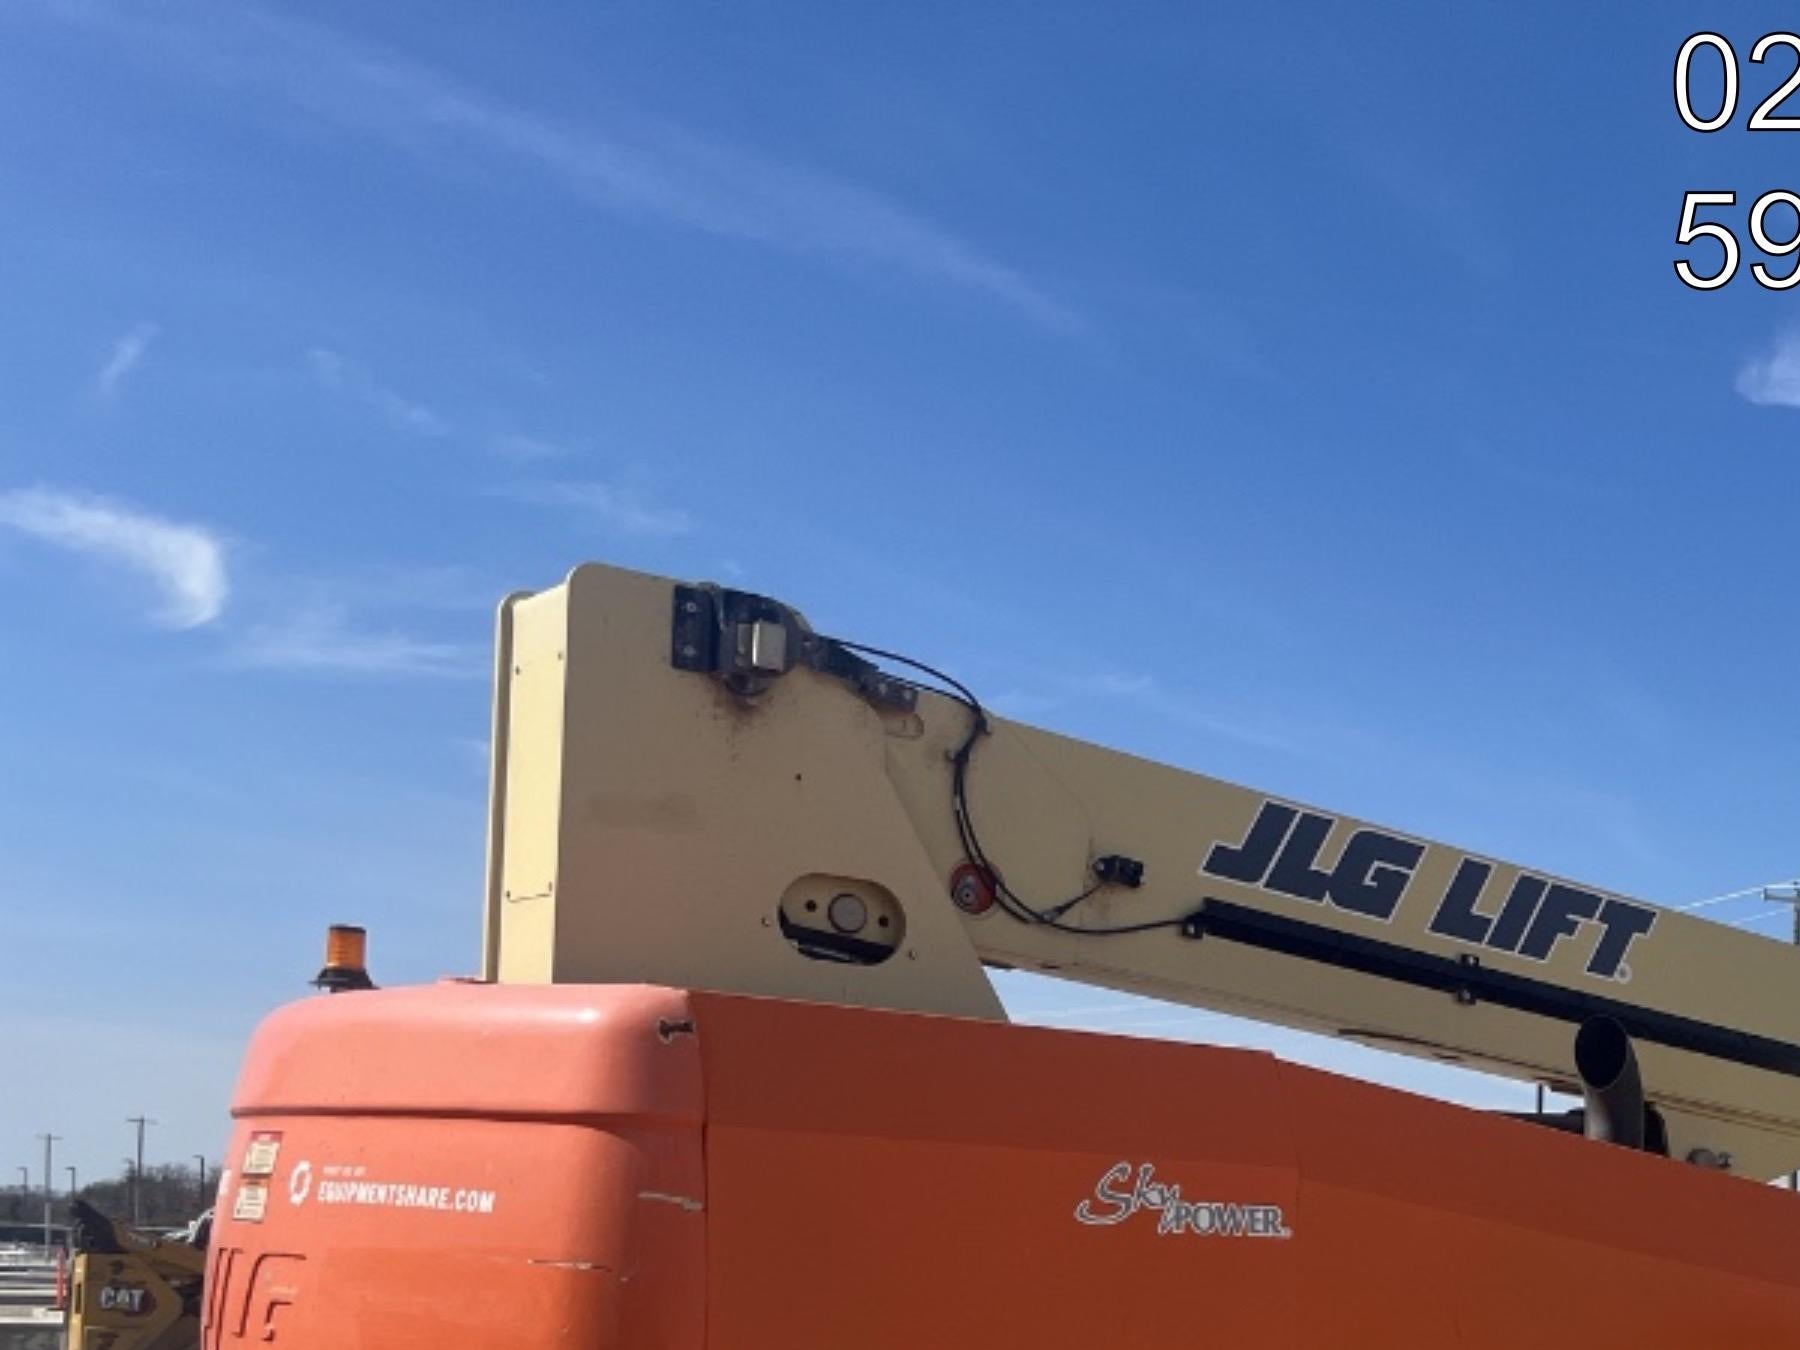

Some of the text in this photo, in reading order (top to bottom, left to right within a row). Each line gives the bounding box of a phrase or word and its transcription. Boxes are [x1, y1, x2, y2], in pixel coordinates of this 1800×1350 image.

[1199, 798, 1659, 981] JLG LIFT
[317, 1180, 497, 1214] EQUIPMENTSHARE.COM
[1073, 1160, 1285, 1238] Sky POWER
[100, 1286, 146, 1313] CAT
